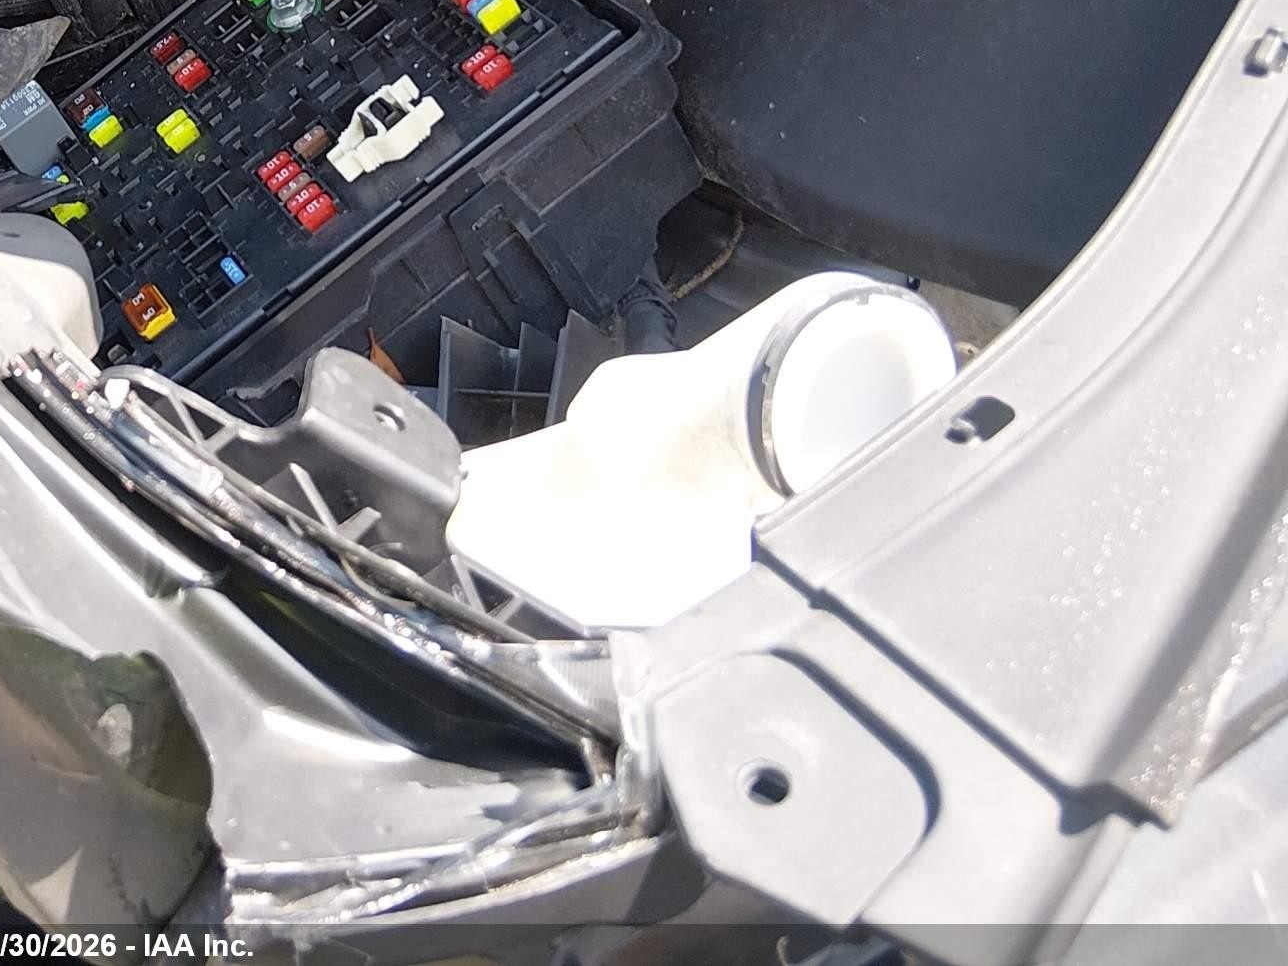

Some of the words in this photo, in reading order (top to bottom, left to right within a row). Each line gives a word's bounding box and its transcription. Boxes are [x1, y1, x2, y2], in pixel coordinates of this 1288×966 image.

[470, 51, 484, 63] 10
[181, 64, 192, 74] 10
[482, 60, 497, 73] 10
[266, 157, 279, 169] 10
[275, 168, 288, 180] 10
[295, 190, 308, 202] 10
[305, 200, 319, 212] 10
